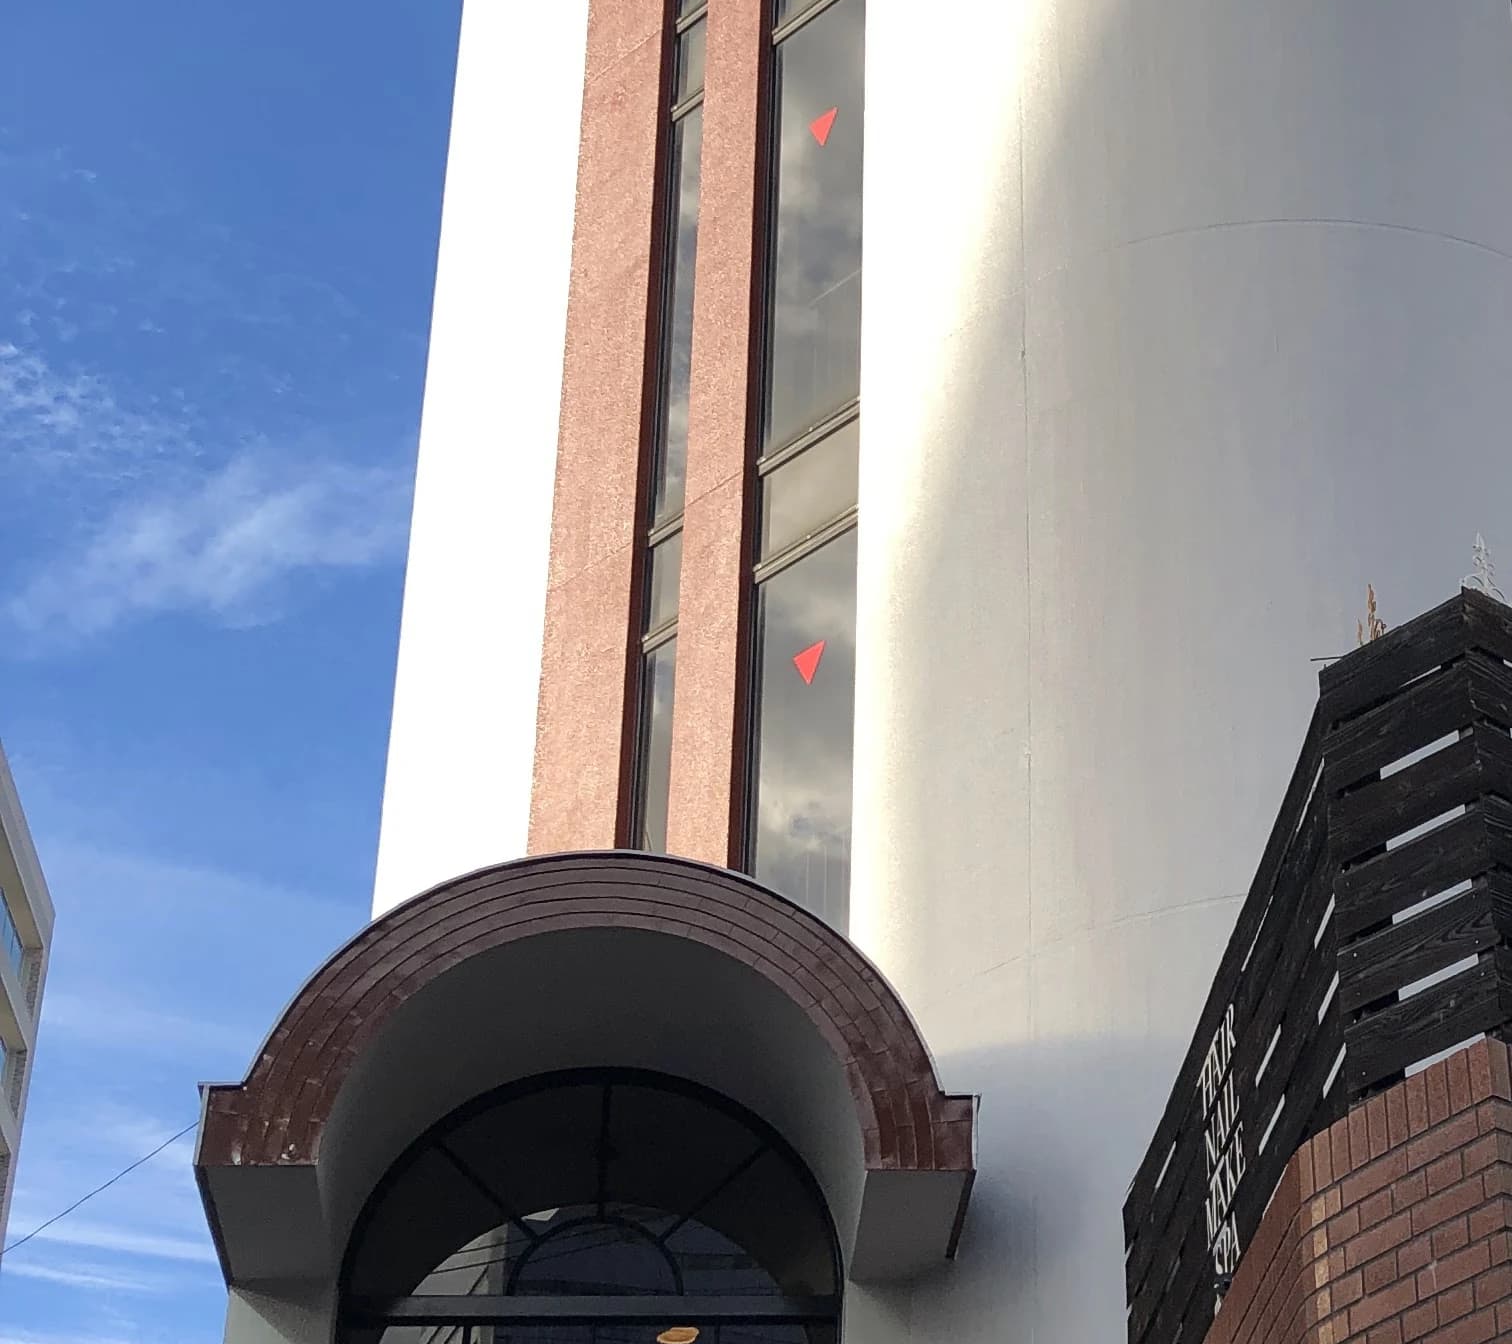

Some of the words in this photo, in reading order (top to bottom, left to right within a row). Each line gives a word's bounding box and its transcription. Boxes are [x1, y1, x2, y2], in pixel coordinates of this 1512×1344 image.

[1196, 1003, 1237, 1121] HAIR
[1204, 1069, 1241, 1180] NAIL
[1205, 1126, 1247, 1252] MAKE
